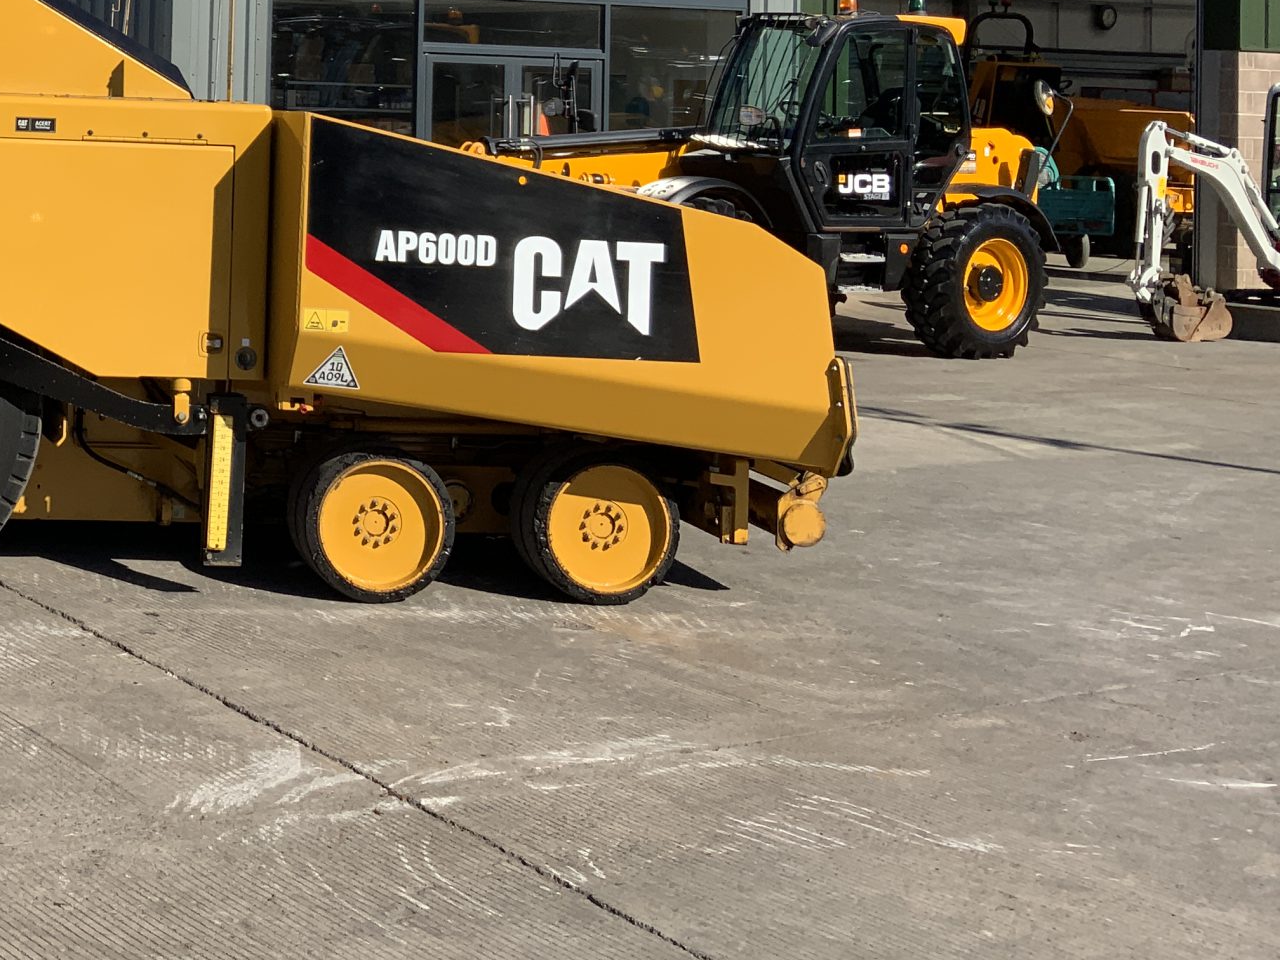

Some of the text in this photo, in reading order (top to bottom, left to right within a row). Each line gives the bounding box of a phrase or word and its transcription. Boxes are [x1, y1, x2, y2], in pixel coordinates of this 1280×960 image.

[838, 173, 890, 193] JCB
[375, 229, 497, 267] AP600D
[512, 235, 665, 336] CAT
